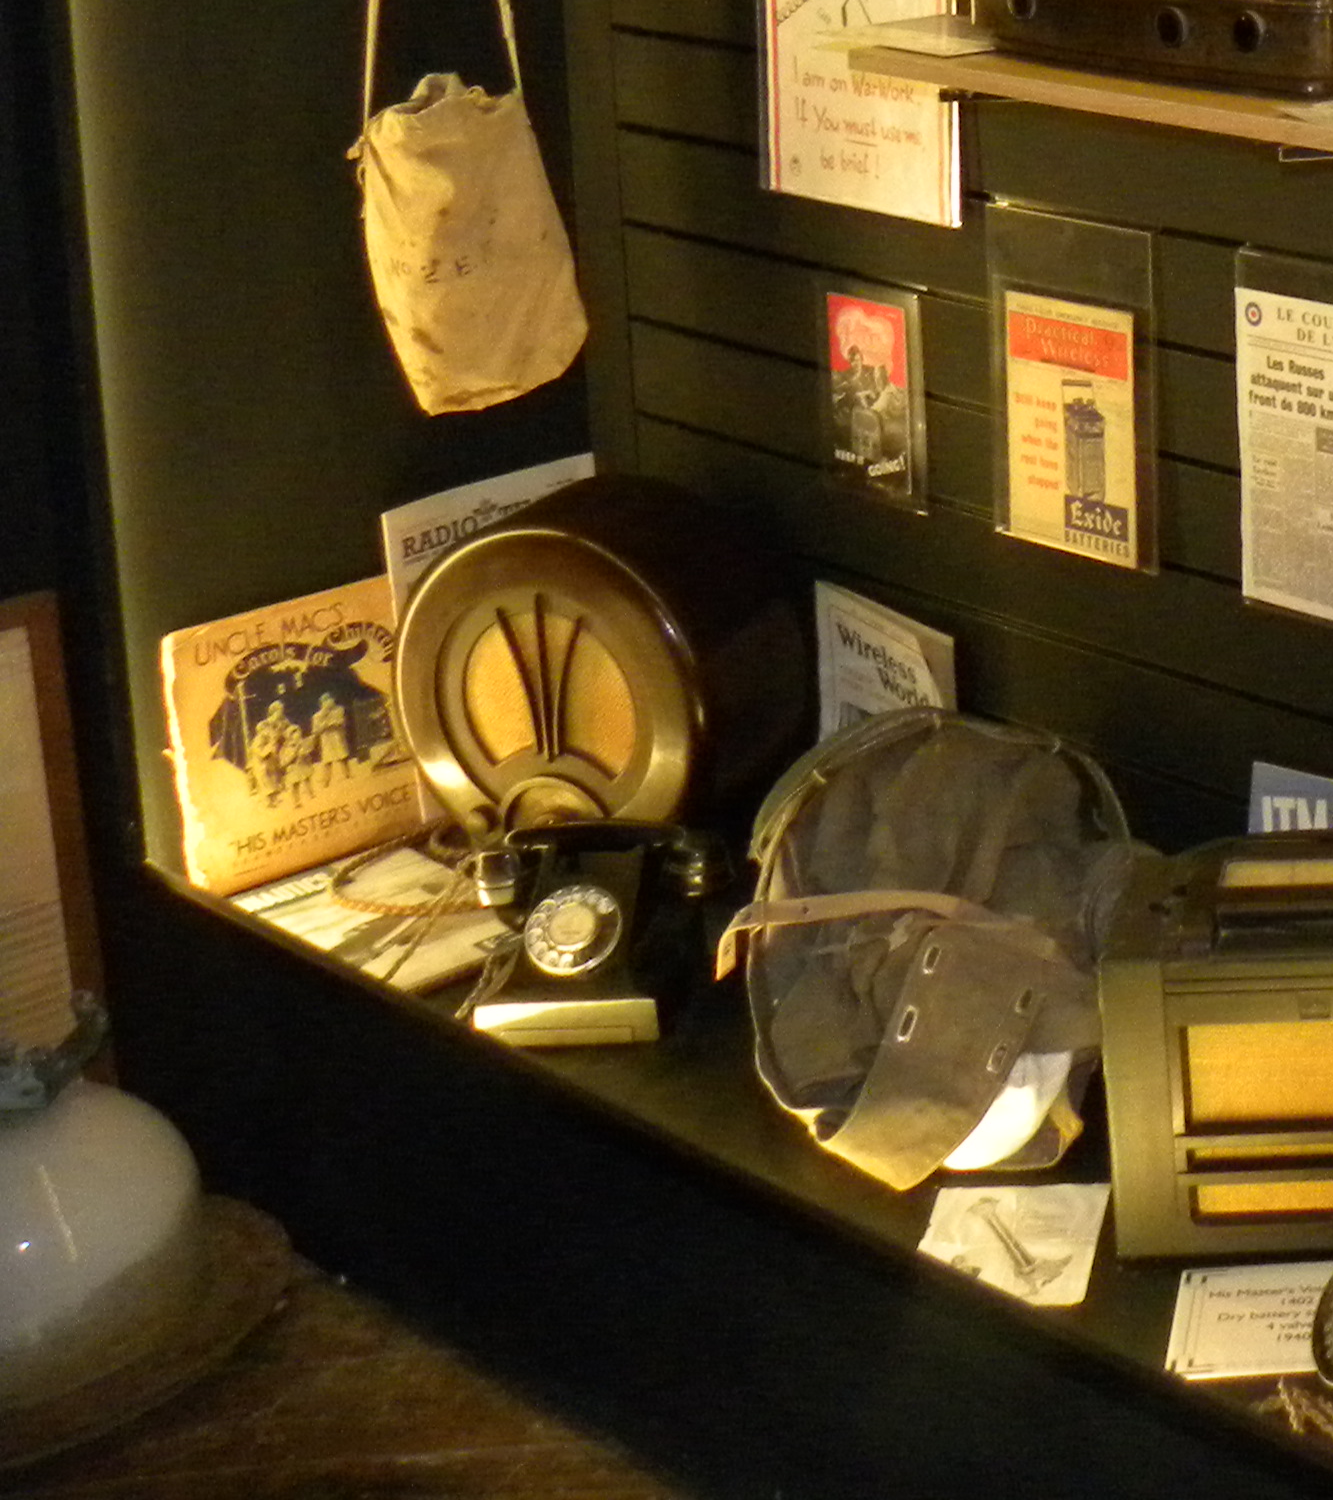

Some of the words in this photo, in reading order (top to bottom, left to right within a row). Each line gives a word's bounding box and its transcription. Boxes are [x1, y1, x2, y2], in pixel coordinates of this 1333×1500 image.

[802, 72, 824, 87] am
[830, 78, 847, 92] on
[812, 104, 839, 134] You
[843, 116, 876, 137] must
[820, 146, 835, 170] be
[1277, 307, 1293, 322] LE
[1297, 328, 1315, 343] DE
[1266, 356, 1284, 372] Les
[1289, 359, 1325, 380] Russes
[1250, 372, 1302, 395] attaquent
[1306, 385, 1325, 400] sur
[1248, 389, 1277, 409] front
[1281, 398, 1292, 412] de
[1297, 401, 1316, 417] 800
[1071, 500, 1122, 536] Exide
[402, 515, 478, 559] RADIO
[1064, 528, 1130, 558] BATTERIES
[194, 620, 274, 666] UNCLE
[836, 622, 916, 685] Wireless
[878, 666, 929, 706] World
[1236, 1288, 1295, 1297] Master's
[1217, 1312, 1246, 1322] Dry
[1250, 1311, 1301, 1320] battery
[1268, 1322, 1275, 1330] 4
